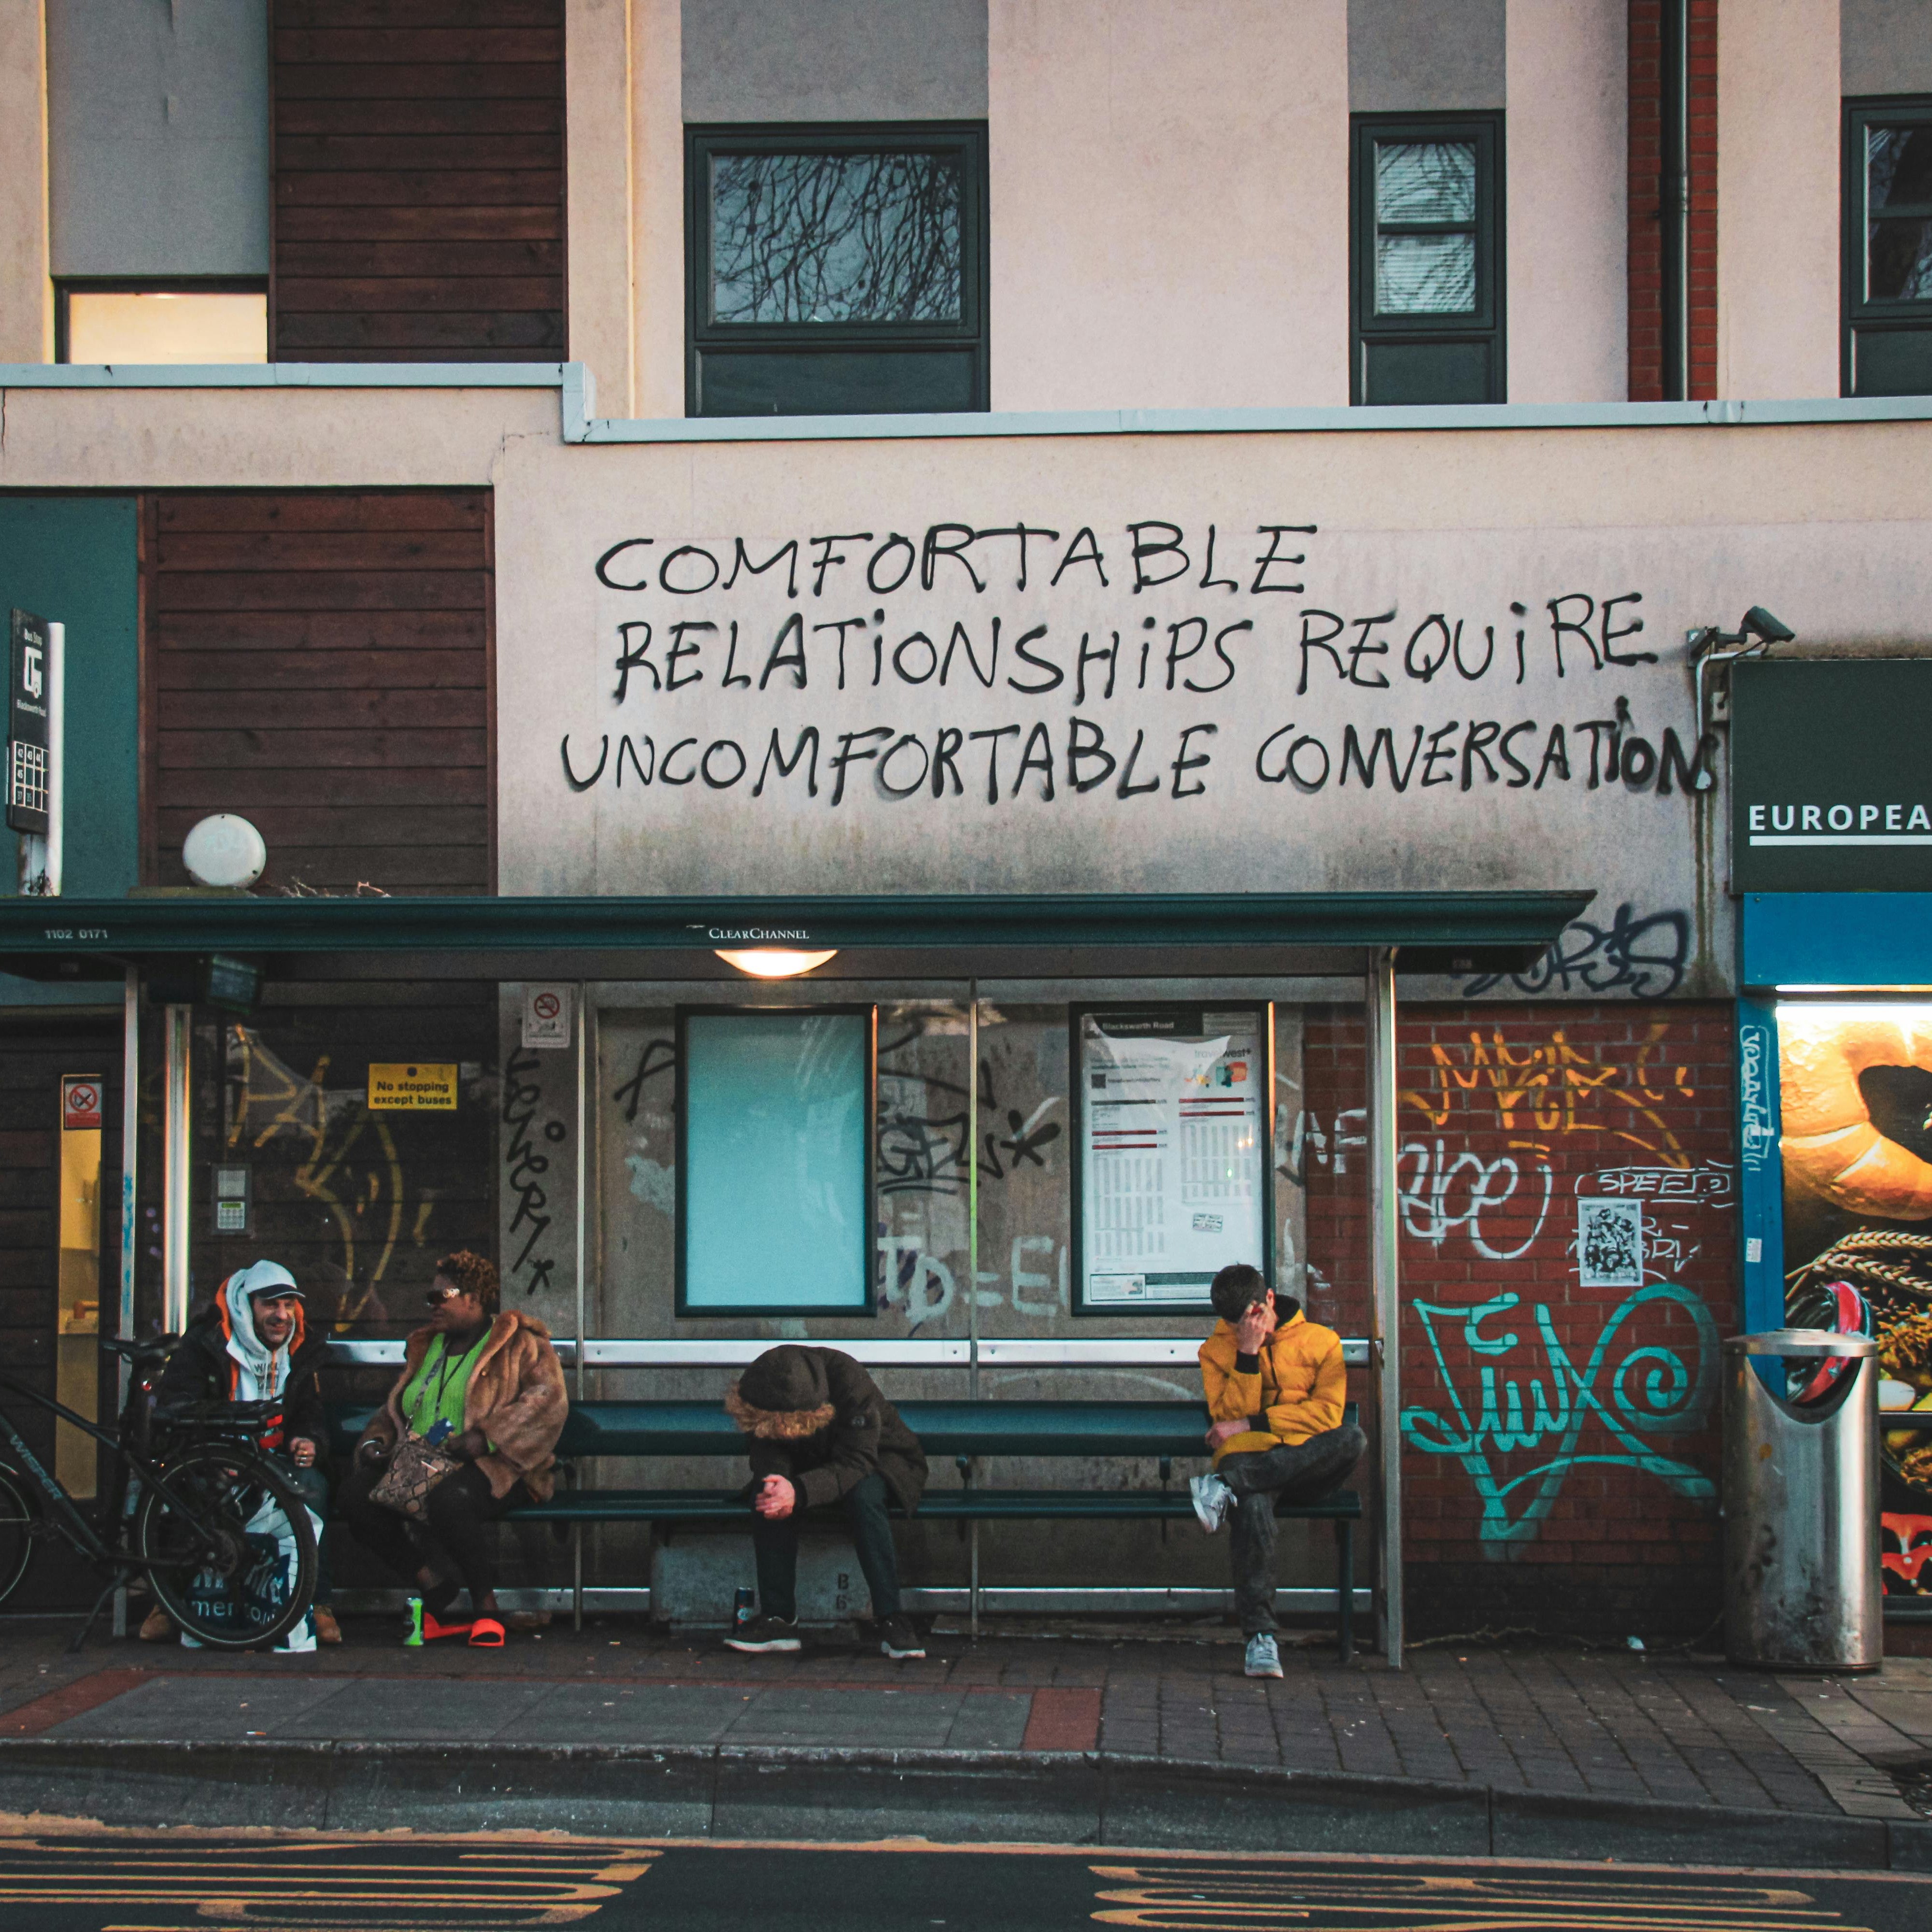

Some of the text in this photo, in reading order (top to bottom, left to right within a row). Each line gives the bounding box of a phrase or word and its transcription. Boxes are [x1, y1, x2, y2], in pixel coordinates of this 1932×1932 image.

[596, 521, 1317, 598] COMFORTABLE
[561, 716, 1218, 807] UNCOMFORTABLE
[1749, 805, 1932, 830] EUROPEA
[44, 929, 108, 939] 1102 0171
[376, 1081, 449, 1093] No stopping
[374, 1095, 452, 1105] except buses
[838, 1574, 849, 1590] B
